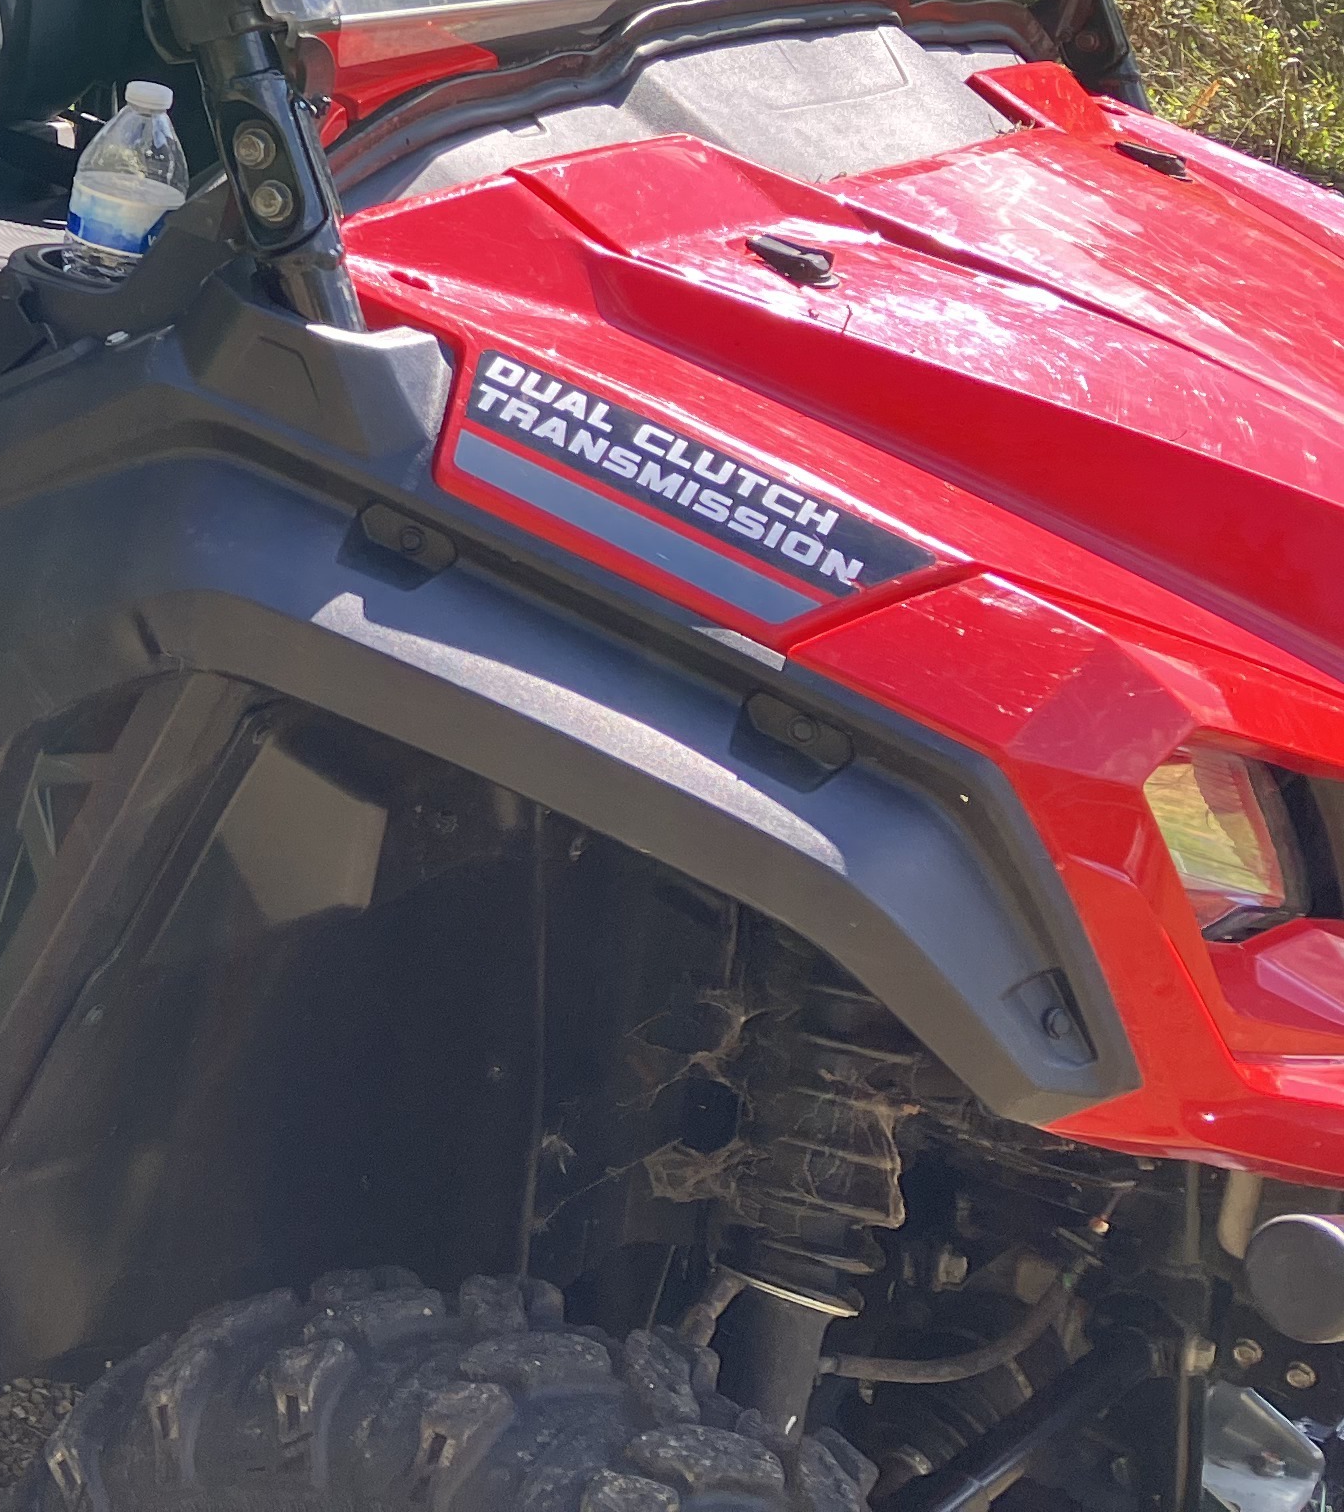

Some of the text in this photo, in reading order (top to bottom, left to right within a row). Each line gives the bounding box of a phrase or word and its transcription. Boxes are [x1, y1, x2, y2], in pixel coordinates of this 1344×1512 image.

[476, 383, 864, 586] TRANSMISSION
[484, 356, 840, 536] DUAL CLUTCH
